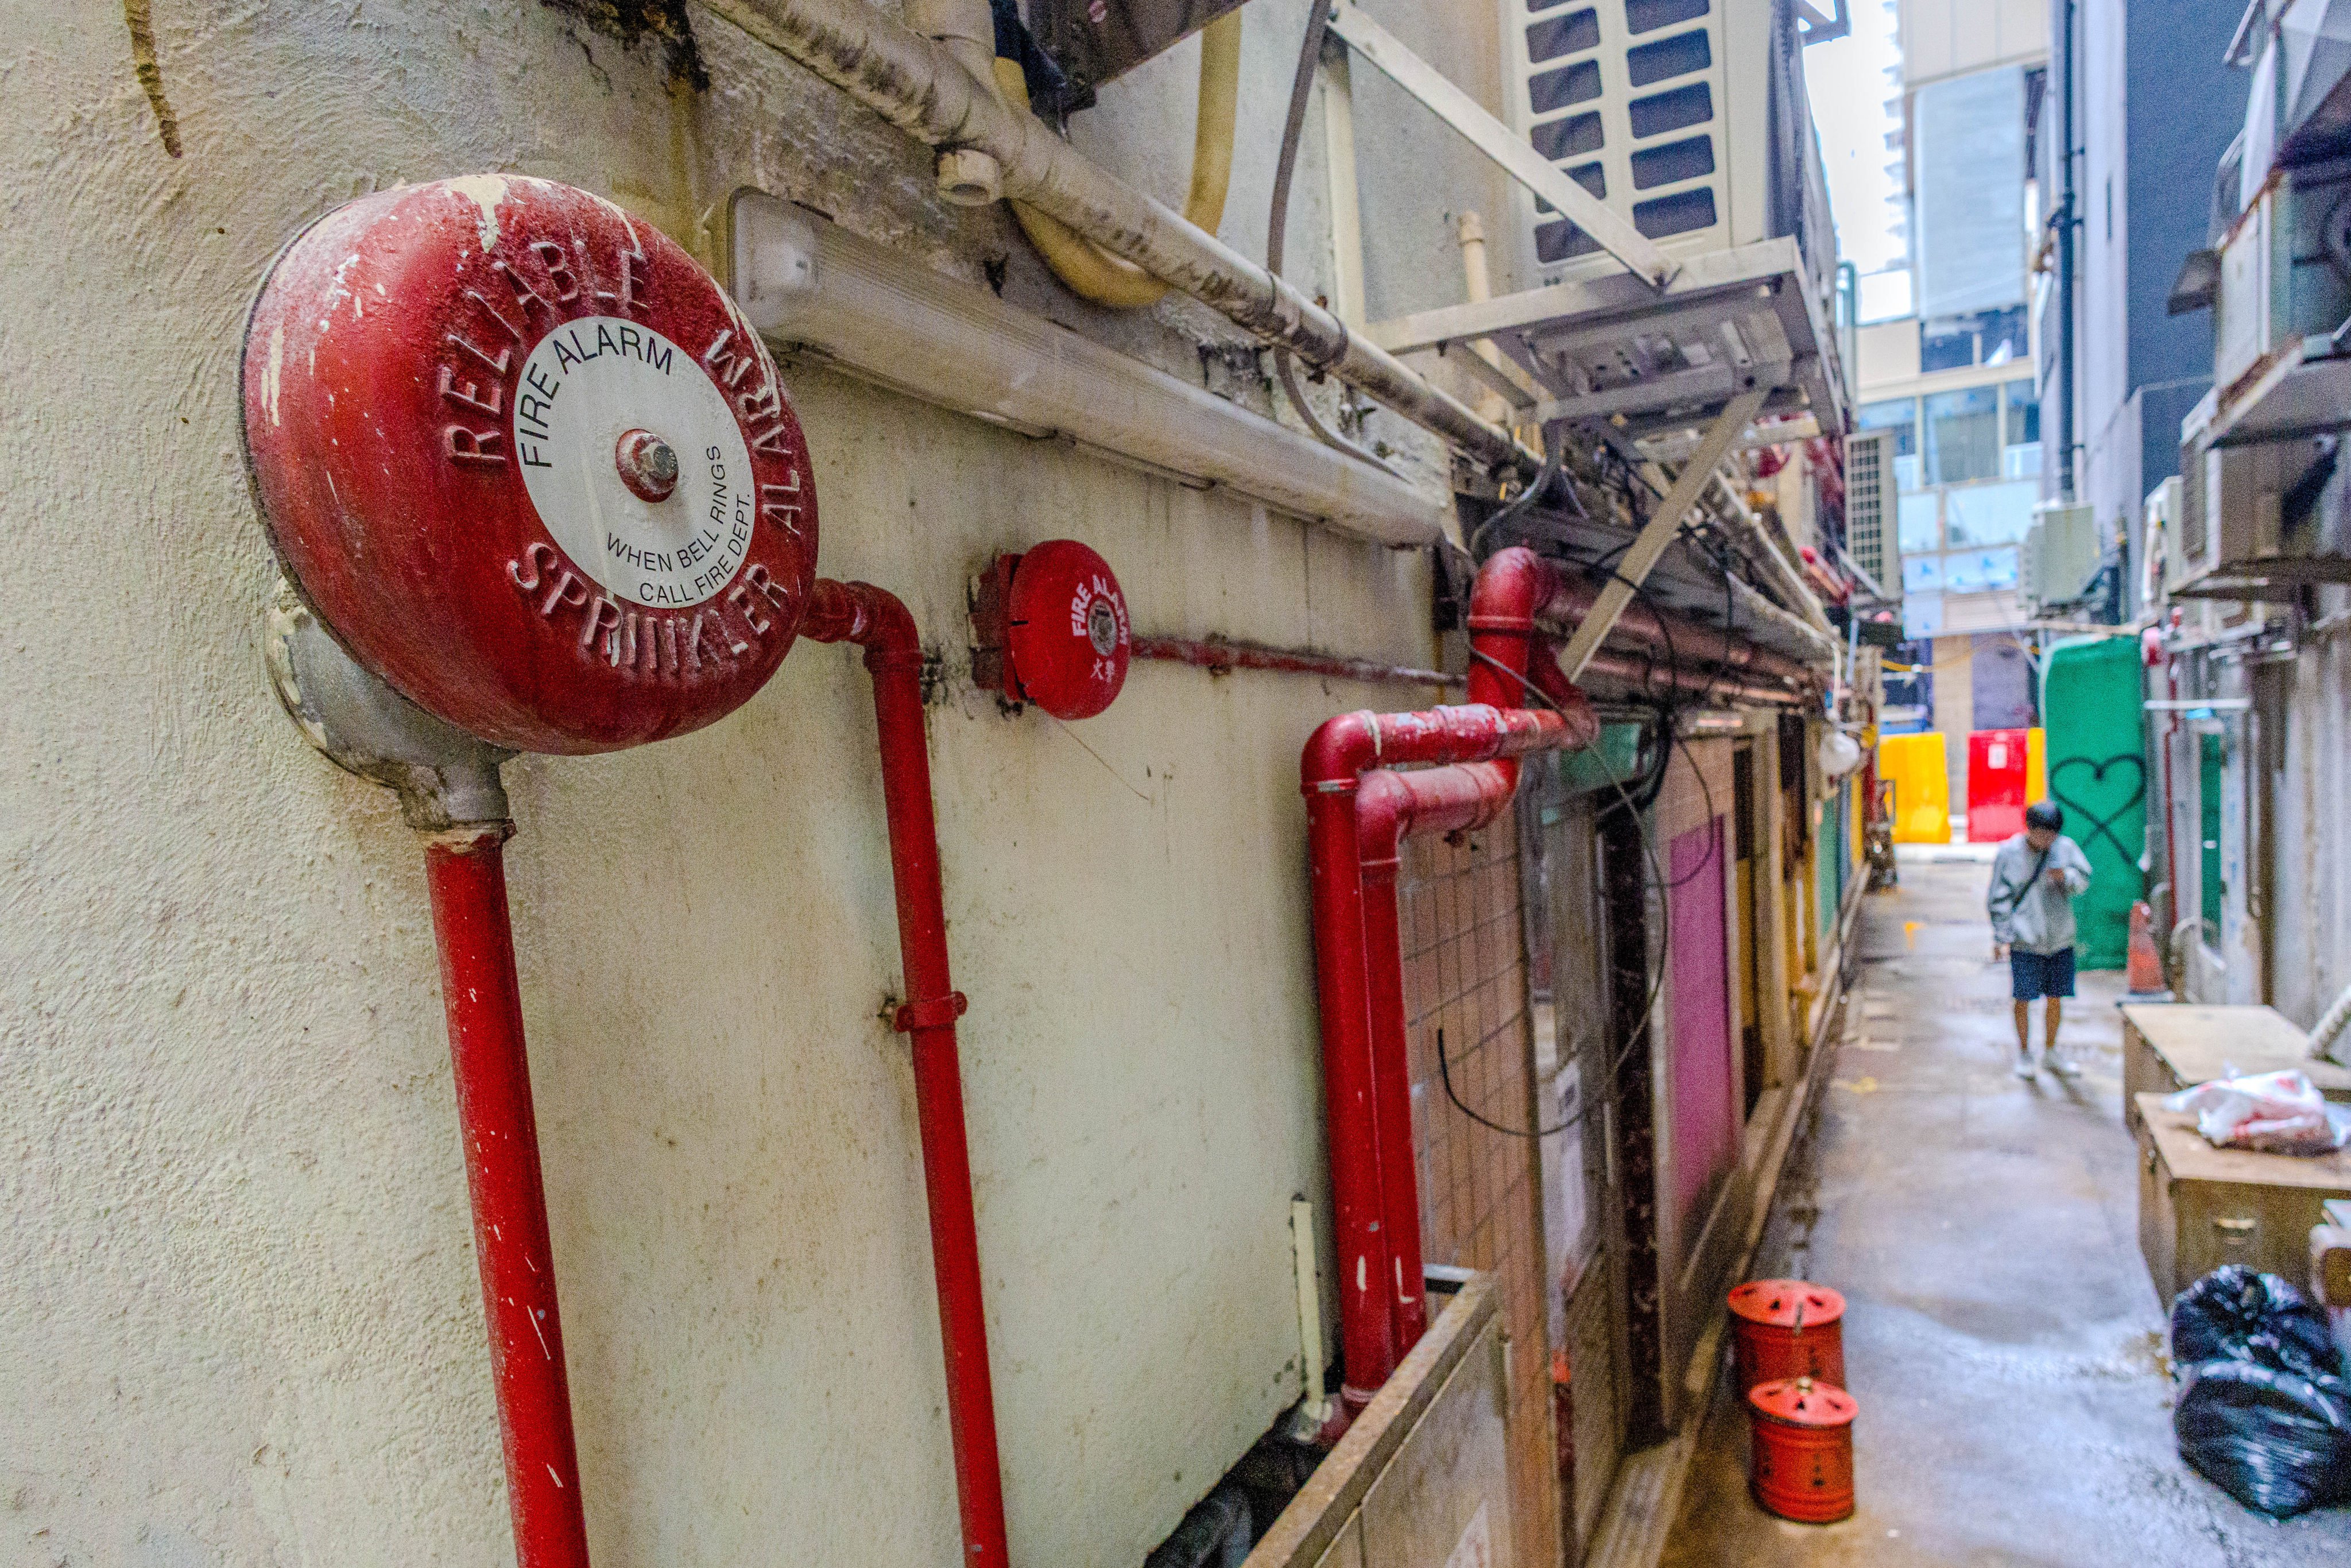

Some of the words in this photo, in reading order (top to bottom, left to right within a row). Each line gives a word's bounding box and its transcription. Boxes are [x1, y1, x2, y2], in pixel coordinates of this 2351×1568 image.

[437, 239, 648, 463] RELIABLE
[520, 363, 560, 467] FIRE
[552, 323, 673, 375] ALARM
[506, 543, 789, 670] SPRINKLER
[705, 328, 802, 536] ALARM
[607, 532, 673, 572] WHEN
[678, 531, 720, 570] BELL
[706, 444, 727, 523] RINGS
[639, 582, 694, 605] CALL
[694, 555, 738, 598] FIRE
[728, 493, 750, 557] DEPT.
[1071, 582, 1091, 637] FIRE
